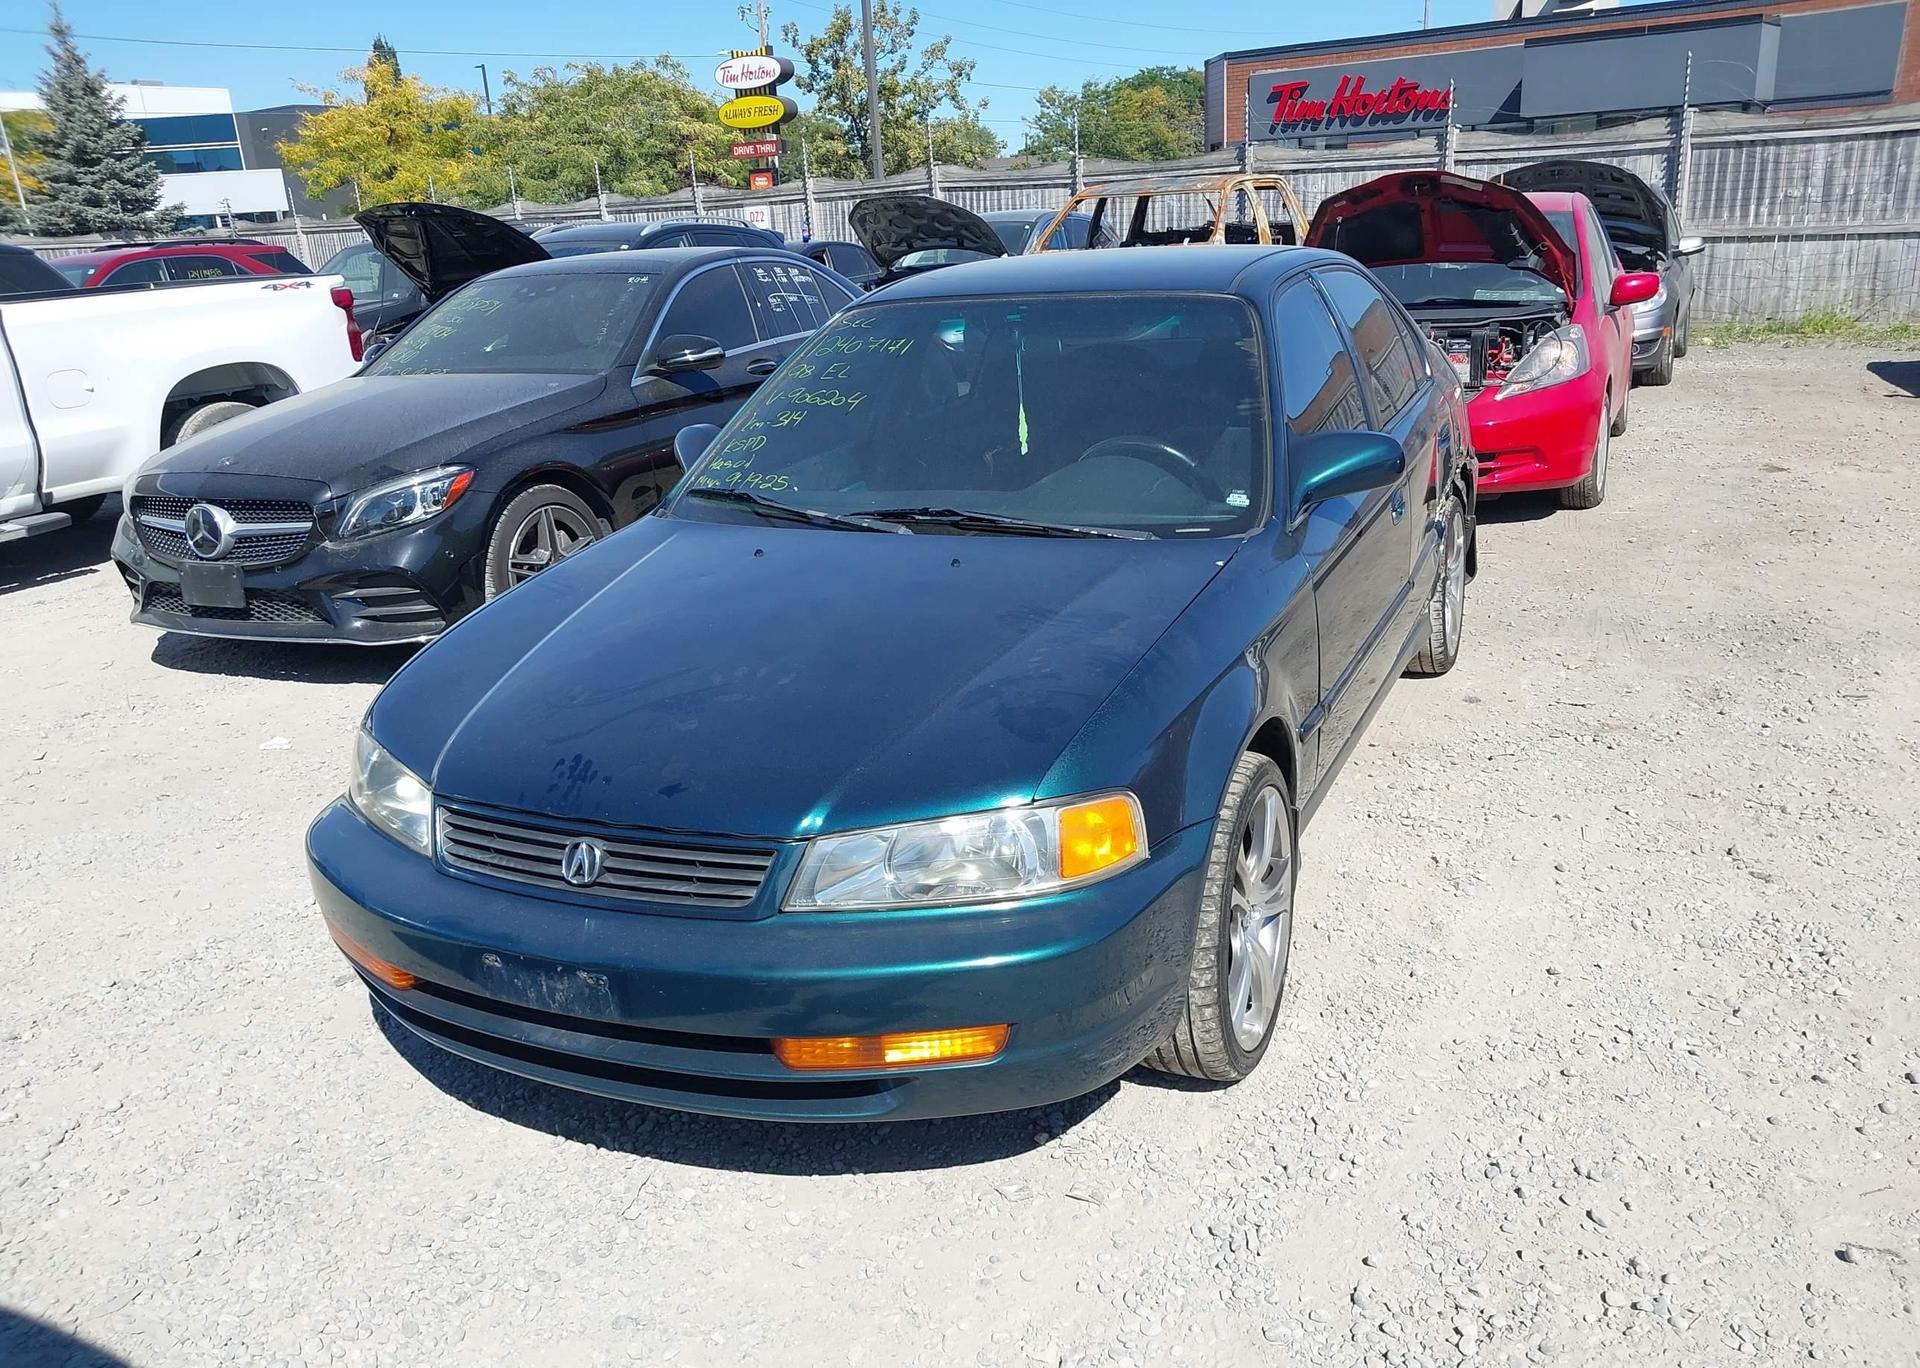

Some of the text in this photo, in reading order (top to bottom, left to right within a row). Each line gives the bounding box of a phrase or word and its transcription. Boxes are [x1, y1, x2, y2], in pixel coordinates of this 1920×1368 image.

[720, 63, 776, 84] Tim Hortons
[1271, 74, 1452, 124] Tim Hortons
[723, 104, 779, 120] ALWAYS FRESH
[733, 143, 776, 156] DRIVE THRU
